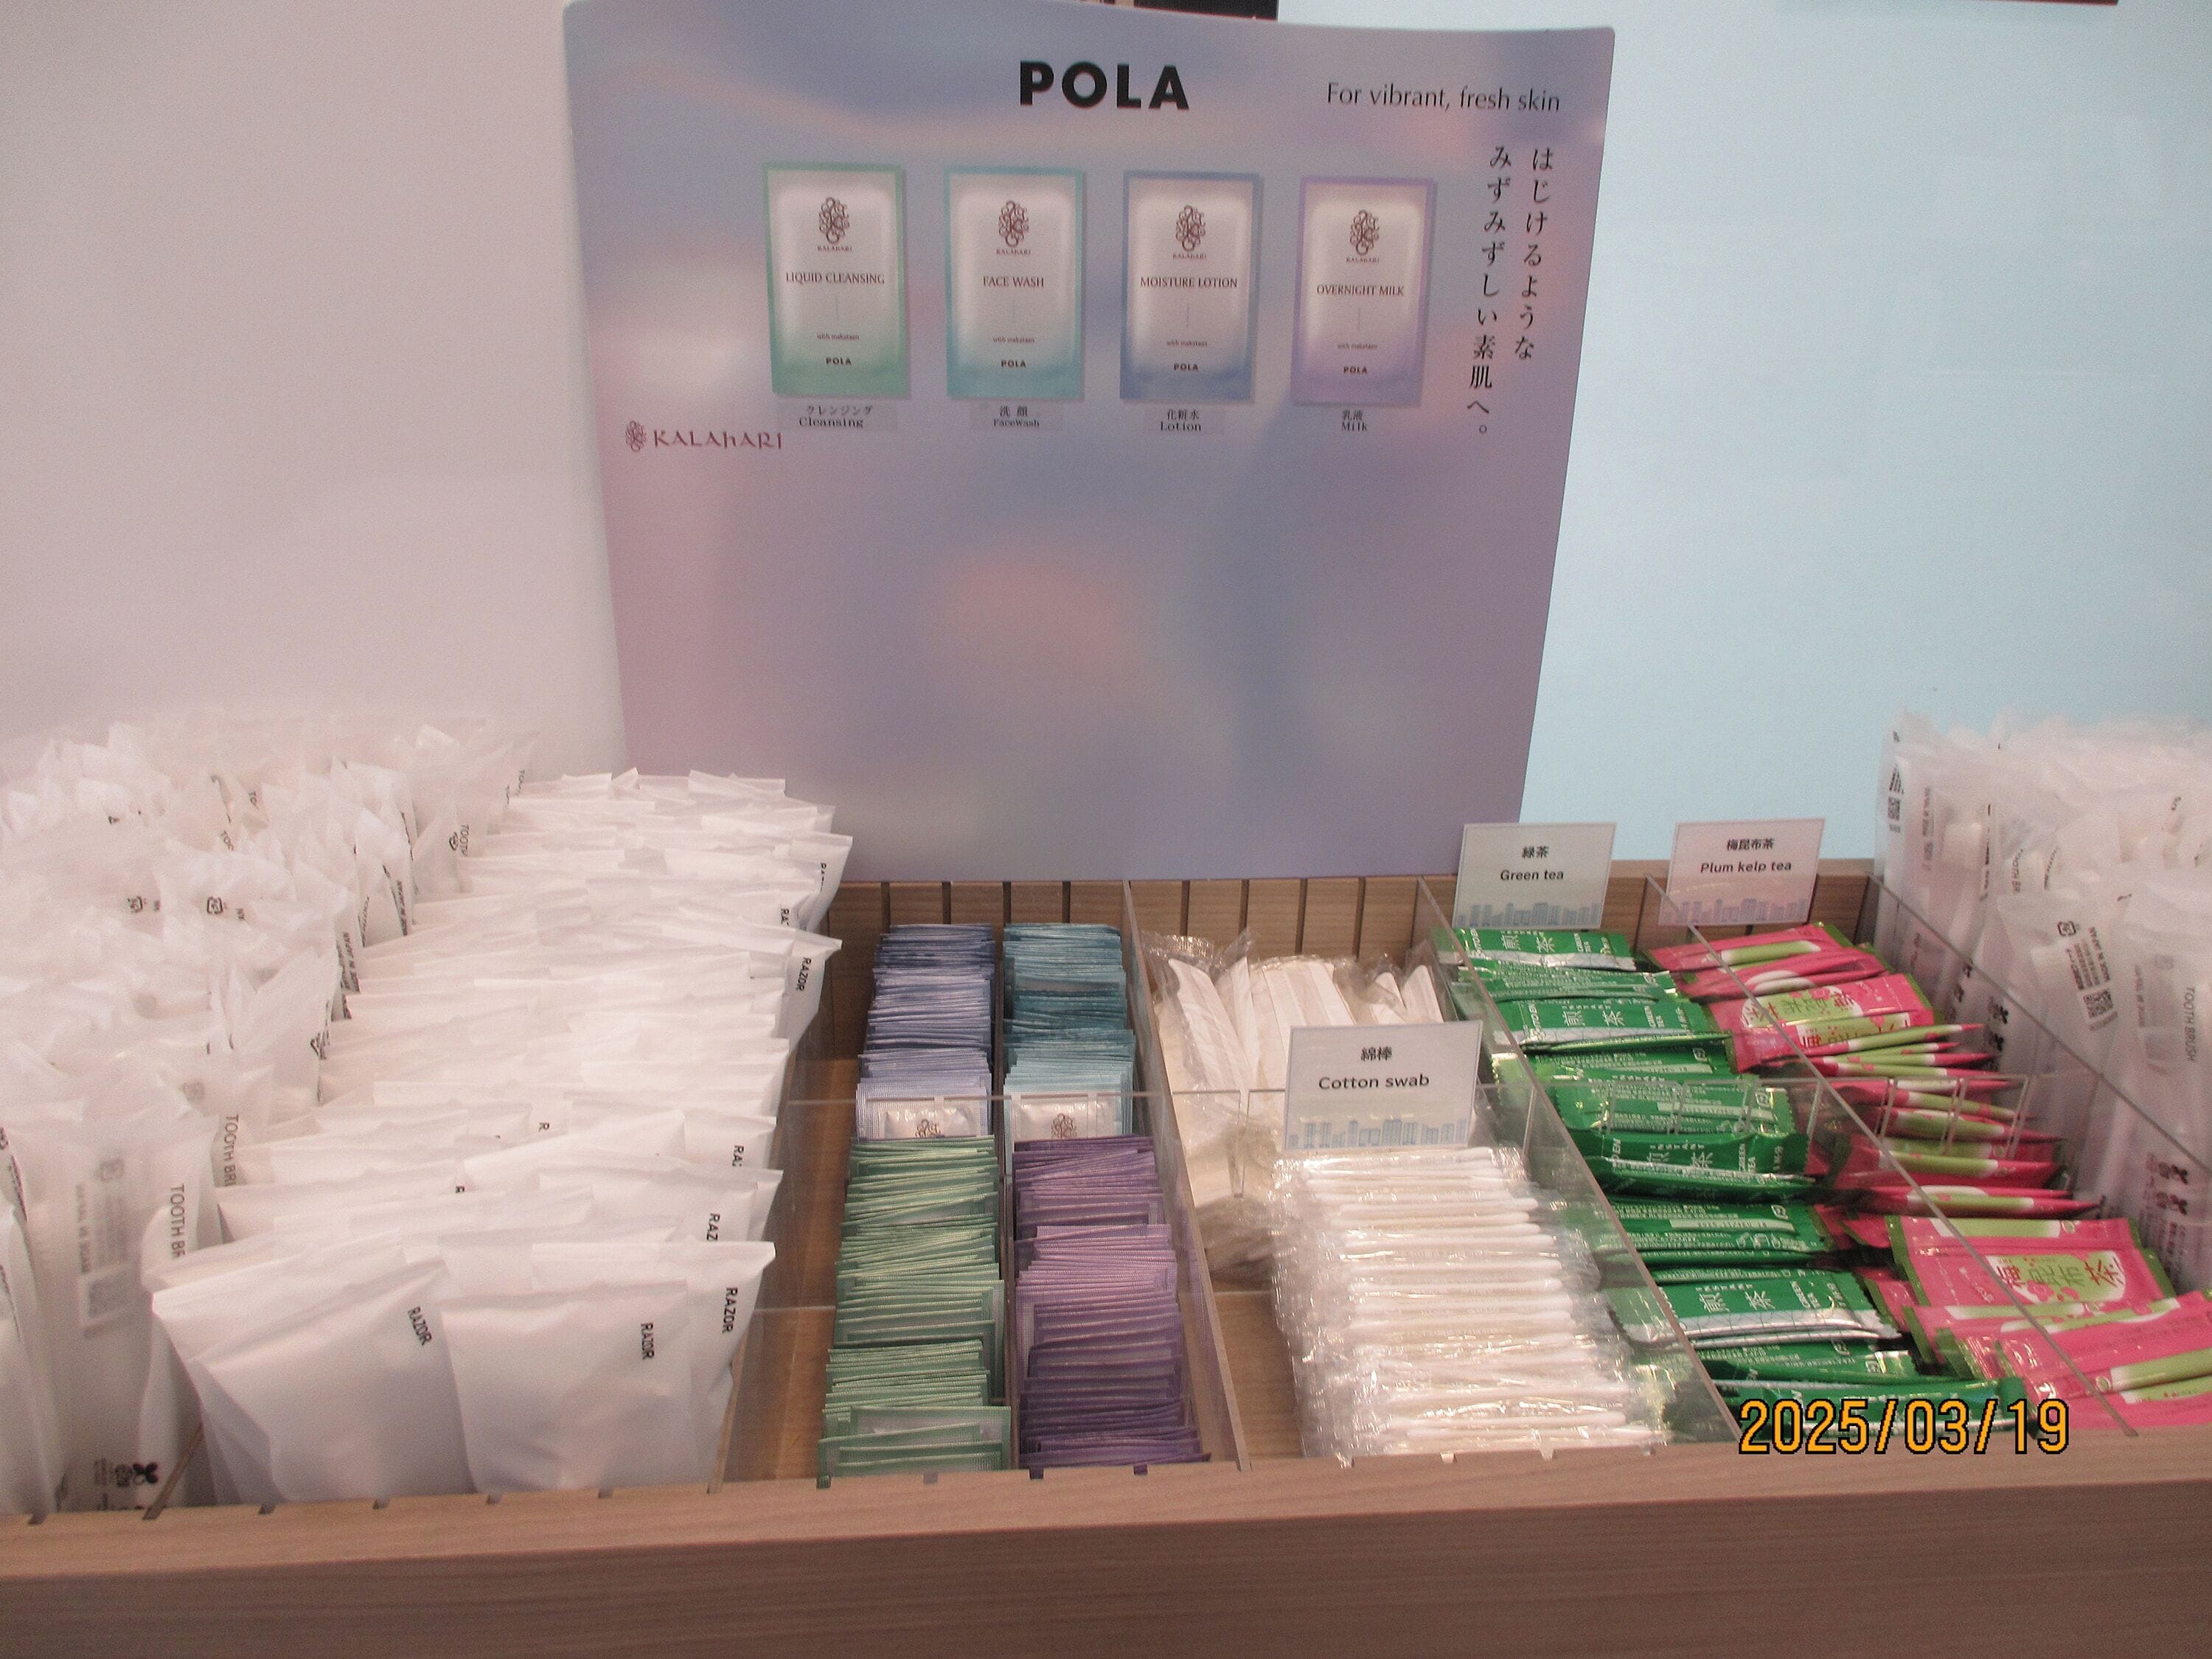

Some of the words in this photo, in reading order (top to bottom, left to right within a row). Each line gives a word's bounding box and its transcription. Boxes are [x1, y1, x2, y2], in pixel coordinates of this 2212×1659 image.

[1020, 59, 1189, 111] POLA
[1327, 82, 1363, 105] For
[1370, 83, 1450, 111] vibrant,
[1461, 85, 1510, 110] fresh
[1518, 88, 1560, 111] skin
[1514, 147, 1554, 360] はじけるような
[786, 272, 822, 285] LIQUID
[825, 273, 886, 285] CLEANSING
[983, 276, 1009, 287] FACE
[1012, 276, 1045, 288] WASH
[1141, 276, 1194, 288] MOISTURE
[1198, 277, 1238, 288] LOTION
[1316, 285, 1377, 296] OVERNIGHT
[1379, 285, 1405, 296] MILK
[1467, 145, 1512, 435] みずみずしい素肌へ。
[825, 357, 852, 366] POLA
[1001, 360, 1027, 368] POLA
[1173, 363, 1199, 372] POLA
[1343, 366, 1368, 375] POLA
[799, 417, 864, 428] Cleansing
[993, 418, 1040, 428] FaceWash
[1160, 421, 1202, 432] Lotion
[1341, 422, 1368, 431] Milk
[1726, 838, 1774, 851] 梅昆布茶
[1522, 846, 1548, 858] 緑茶
[1700, 863, 1734, 874] Plum
[1738, 861, 1767, 873] kelp
[1771, 861, 1792, 872] tea
[1500, 869, 1540, 881] Green
[1543, 869, 1564, 880] tea
[796, 956, 812, 992] RAZOR
[2183, 987, 2195, 1023] TOOTH
[1360, 1046, 1392, 1062] 綿棒
[1318, 1077, 1379, 1090] Cotton
[1385, 1074, 1430, 1088] swab
[223, 1114, 239, 1161] TOOTH
[170, 1183, 185, 1237] TOOTH
[706, 1212, 721, 1241] RAZ
[722, 1287, 738, 1334] RAZOR
[407, 1306, 433, 1346] RAZOR
[640, 1321, 655, 1360] RAZOR
